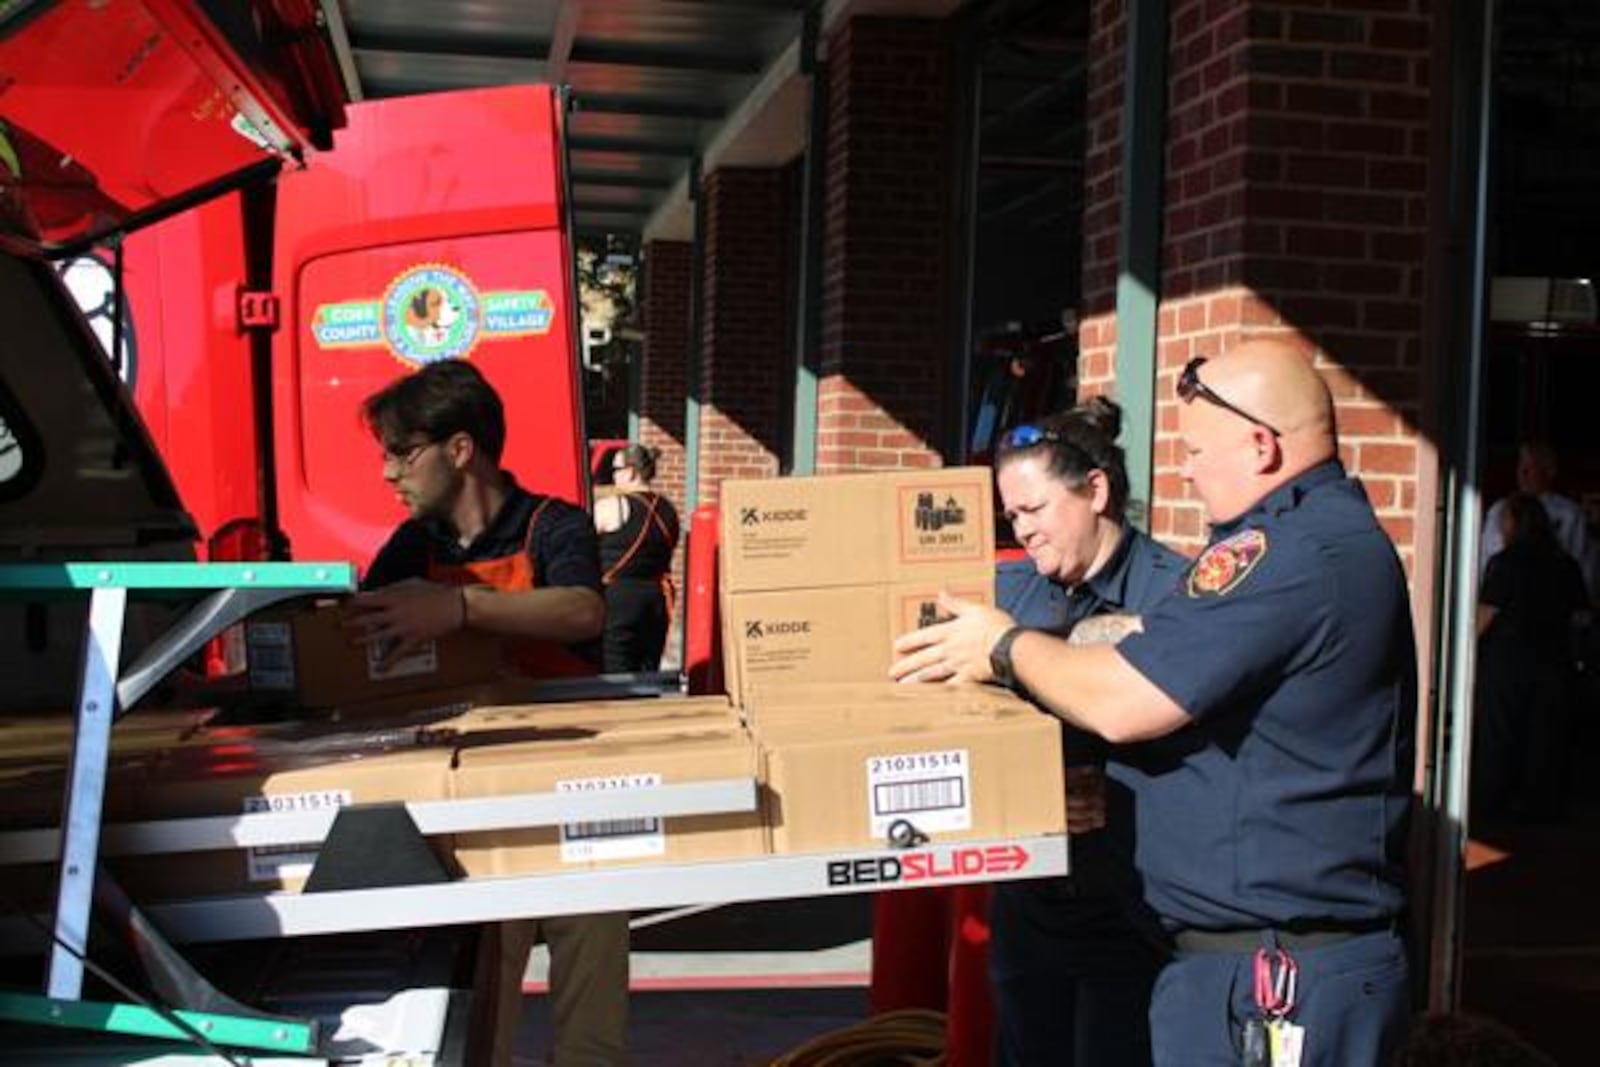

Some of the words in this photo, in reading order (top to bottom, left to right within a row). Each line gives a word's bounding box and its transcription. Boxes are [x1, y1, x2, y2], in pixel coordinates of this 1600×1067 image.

[486, 297, 538, 312] SAFETY
[486, 314, 545, 331] VILLAGE
[319, 325, 378, 341] COUNTY
[762, 509, 808, 522] KIDDE
[765, 621, 812, 634] KIDDE
[872, 753, 962, 773] 21031514
[827, 845, 1030, 887] BEDSLIDE
